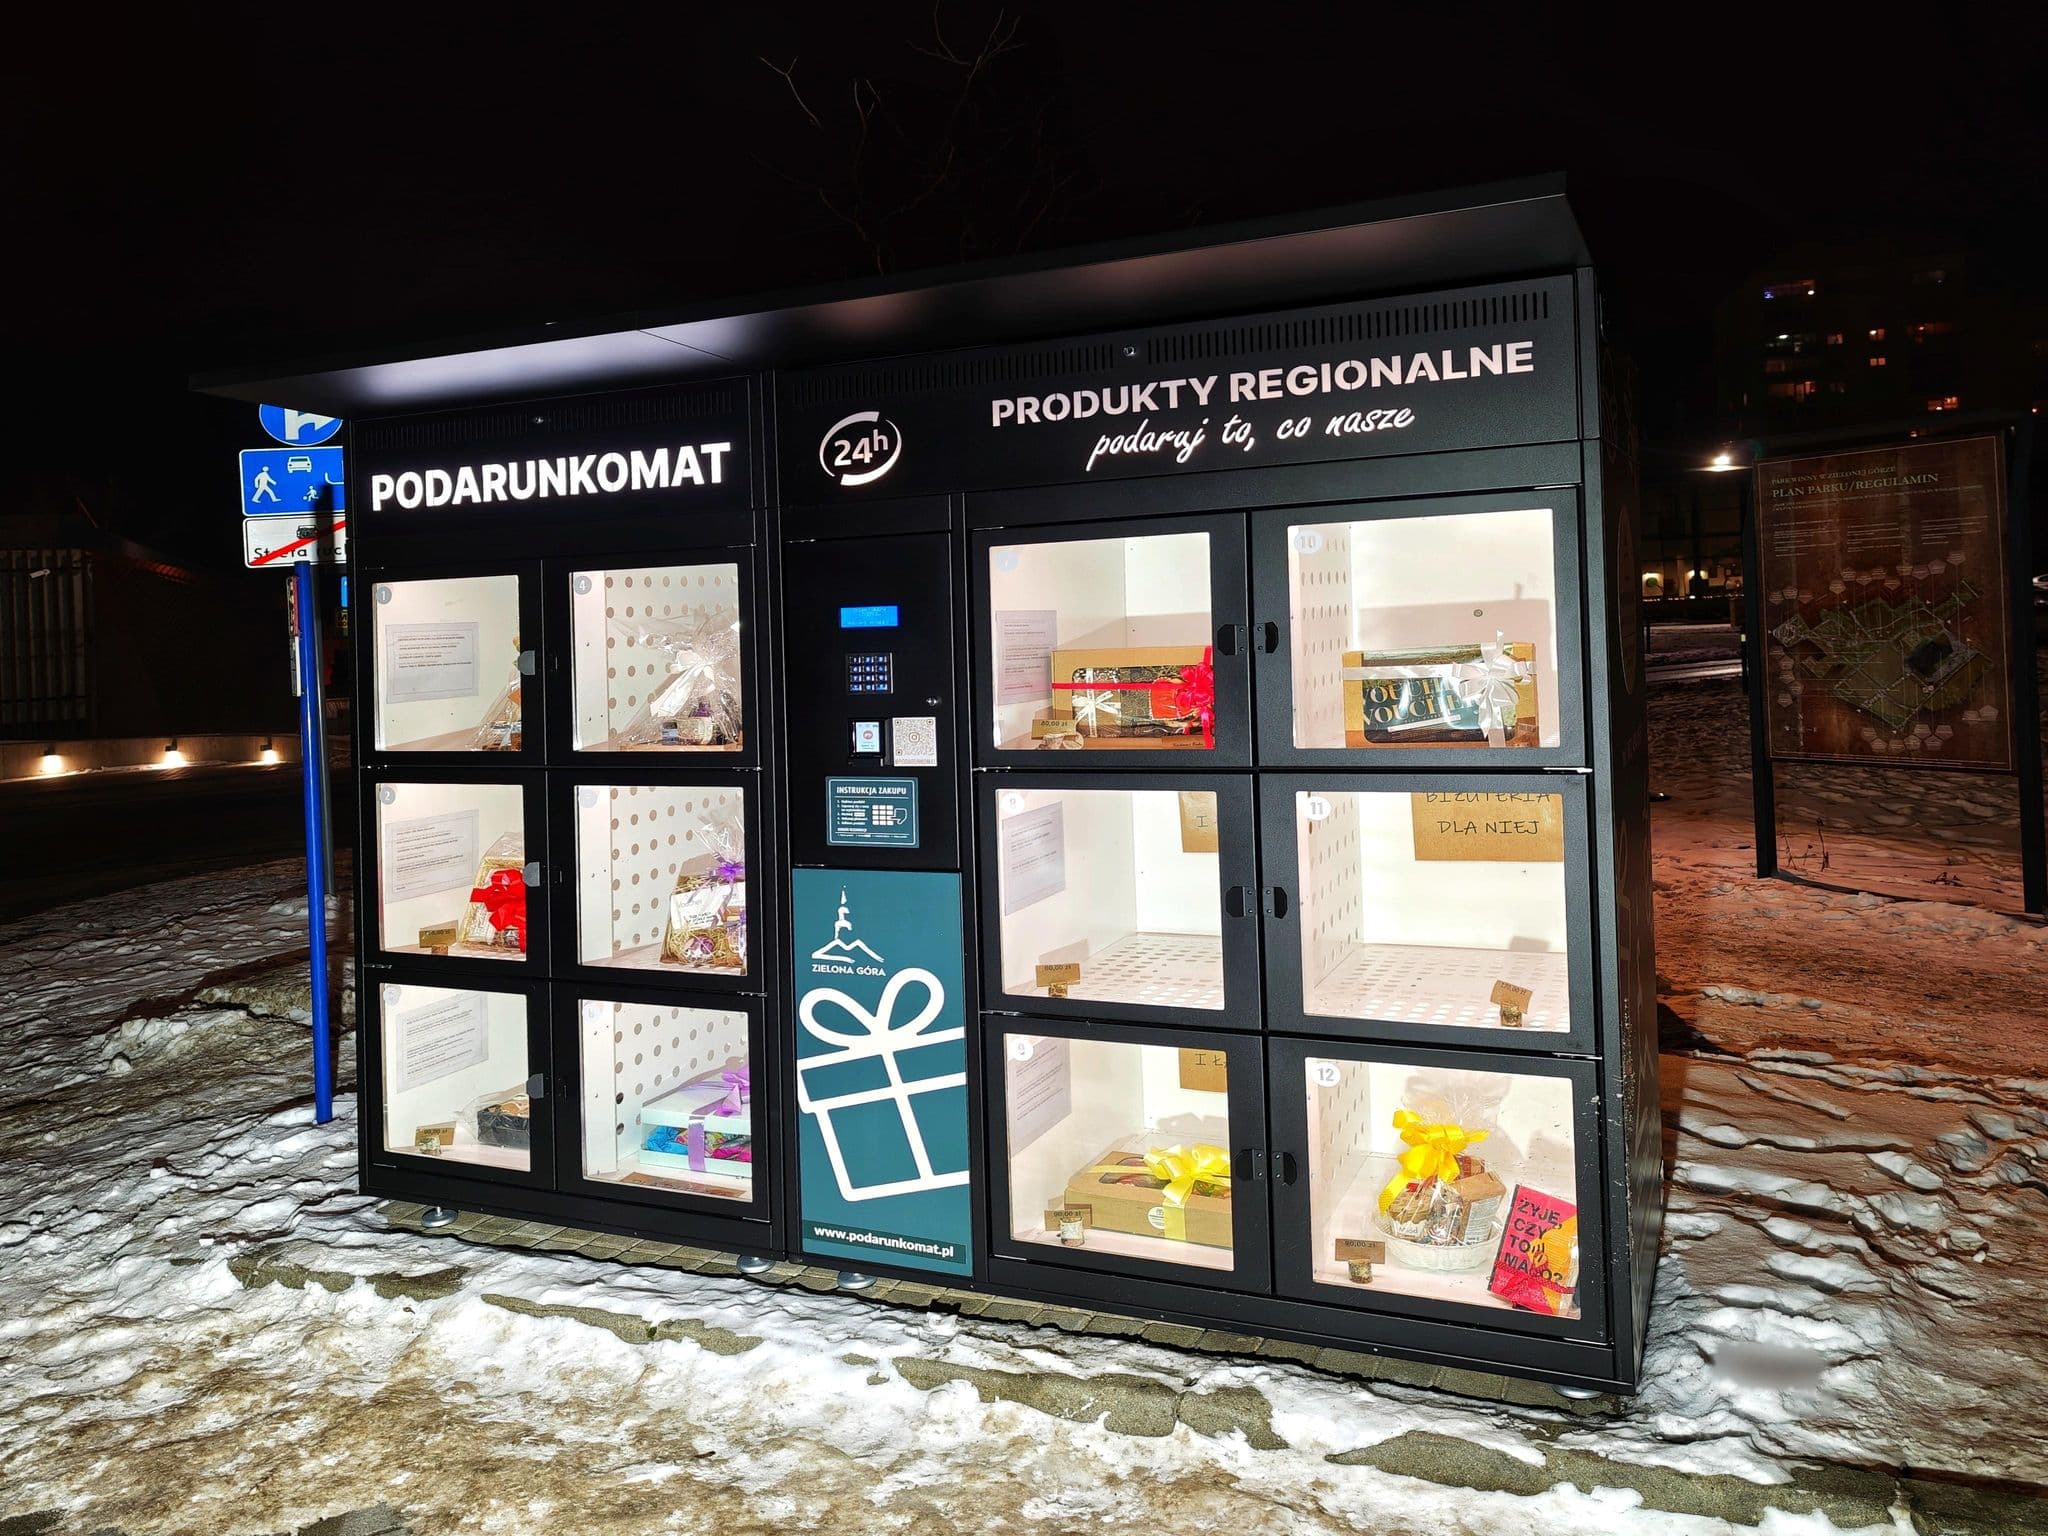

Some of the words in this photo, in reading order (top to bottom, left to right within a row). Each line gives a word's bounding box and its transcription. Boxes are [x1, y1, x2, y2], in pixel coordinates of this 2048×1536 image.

[992, 375, 1218, 428] PRODUKTY
[1229, 340, 1535, 403] REGIONALNE
[833, 428, 889, 467] 24h
[1085, 417, 1210, 471] podaruj
[1222, 411, 1256, 453] to,
[1276, 415, 1312, 440] co
[1325, 407, 1415, 435] nasze
[371, 441, 731, 512] PODARUNKOMAT
[1772, 486, 1805, 498] PLAN
[1808, 472, 1939, 495] PARKU/REGULAMIN
[1299, 535, 1317, 549] 10
[836, 786, 877, 796] INSTRUKCJA
[878, 786, 907, 795] ZAKUPU
[1310, 801, 1324, 816] 11
[1436, 820, 1478, 836] DLA
[1485, 820, 1540, 835] NIEJ
[812, 963, 854, 975] ZIELONA
[856, 965, 886, 977] GÓRA
[1317, 1067, 1336, 1082] 12
[1513, 1217, 1549, 1240] CZY
[814, 1226, 954, 1258] www.podarunkomat.pl
[1509, 1234, 1531, 1253] TO
